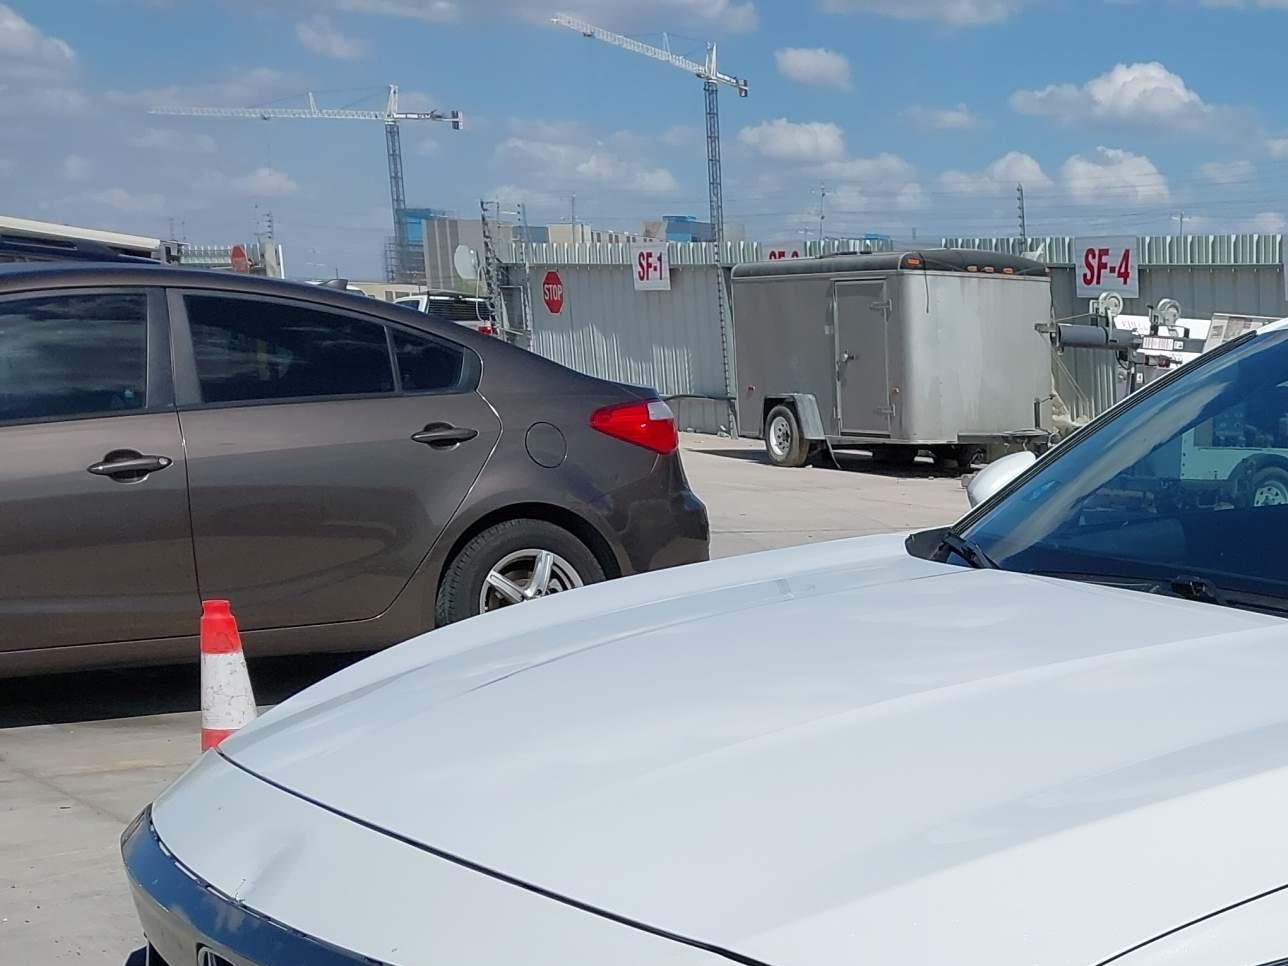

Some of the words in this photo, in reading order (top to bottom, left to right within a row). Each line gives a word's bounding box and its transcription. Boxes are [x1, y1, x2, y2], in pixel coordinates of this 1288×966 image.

[638, 252, 663, 281] SF-1
[1083, 248, 1130, 285] SF-4
[543, 284, 562, 301] STOP
